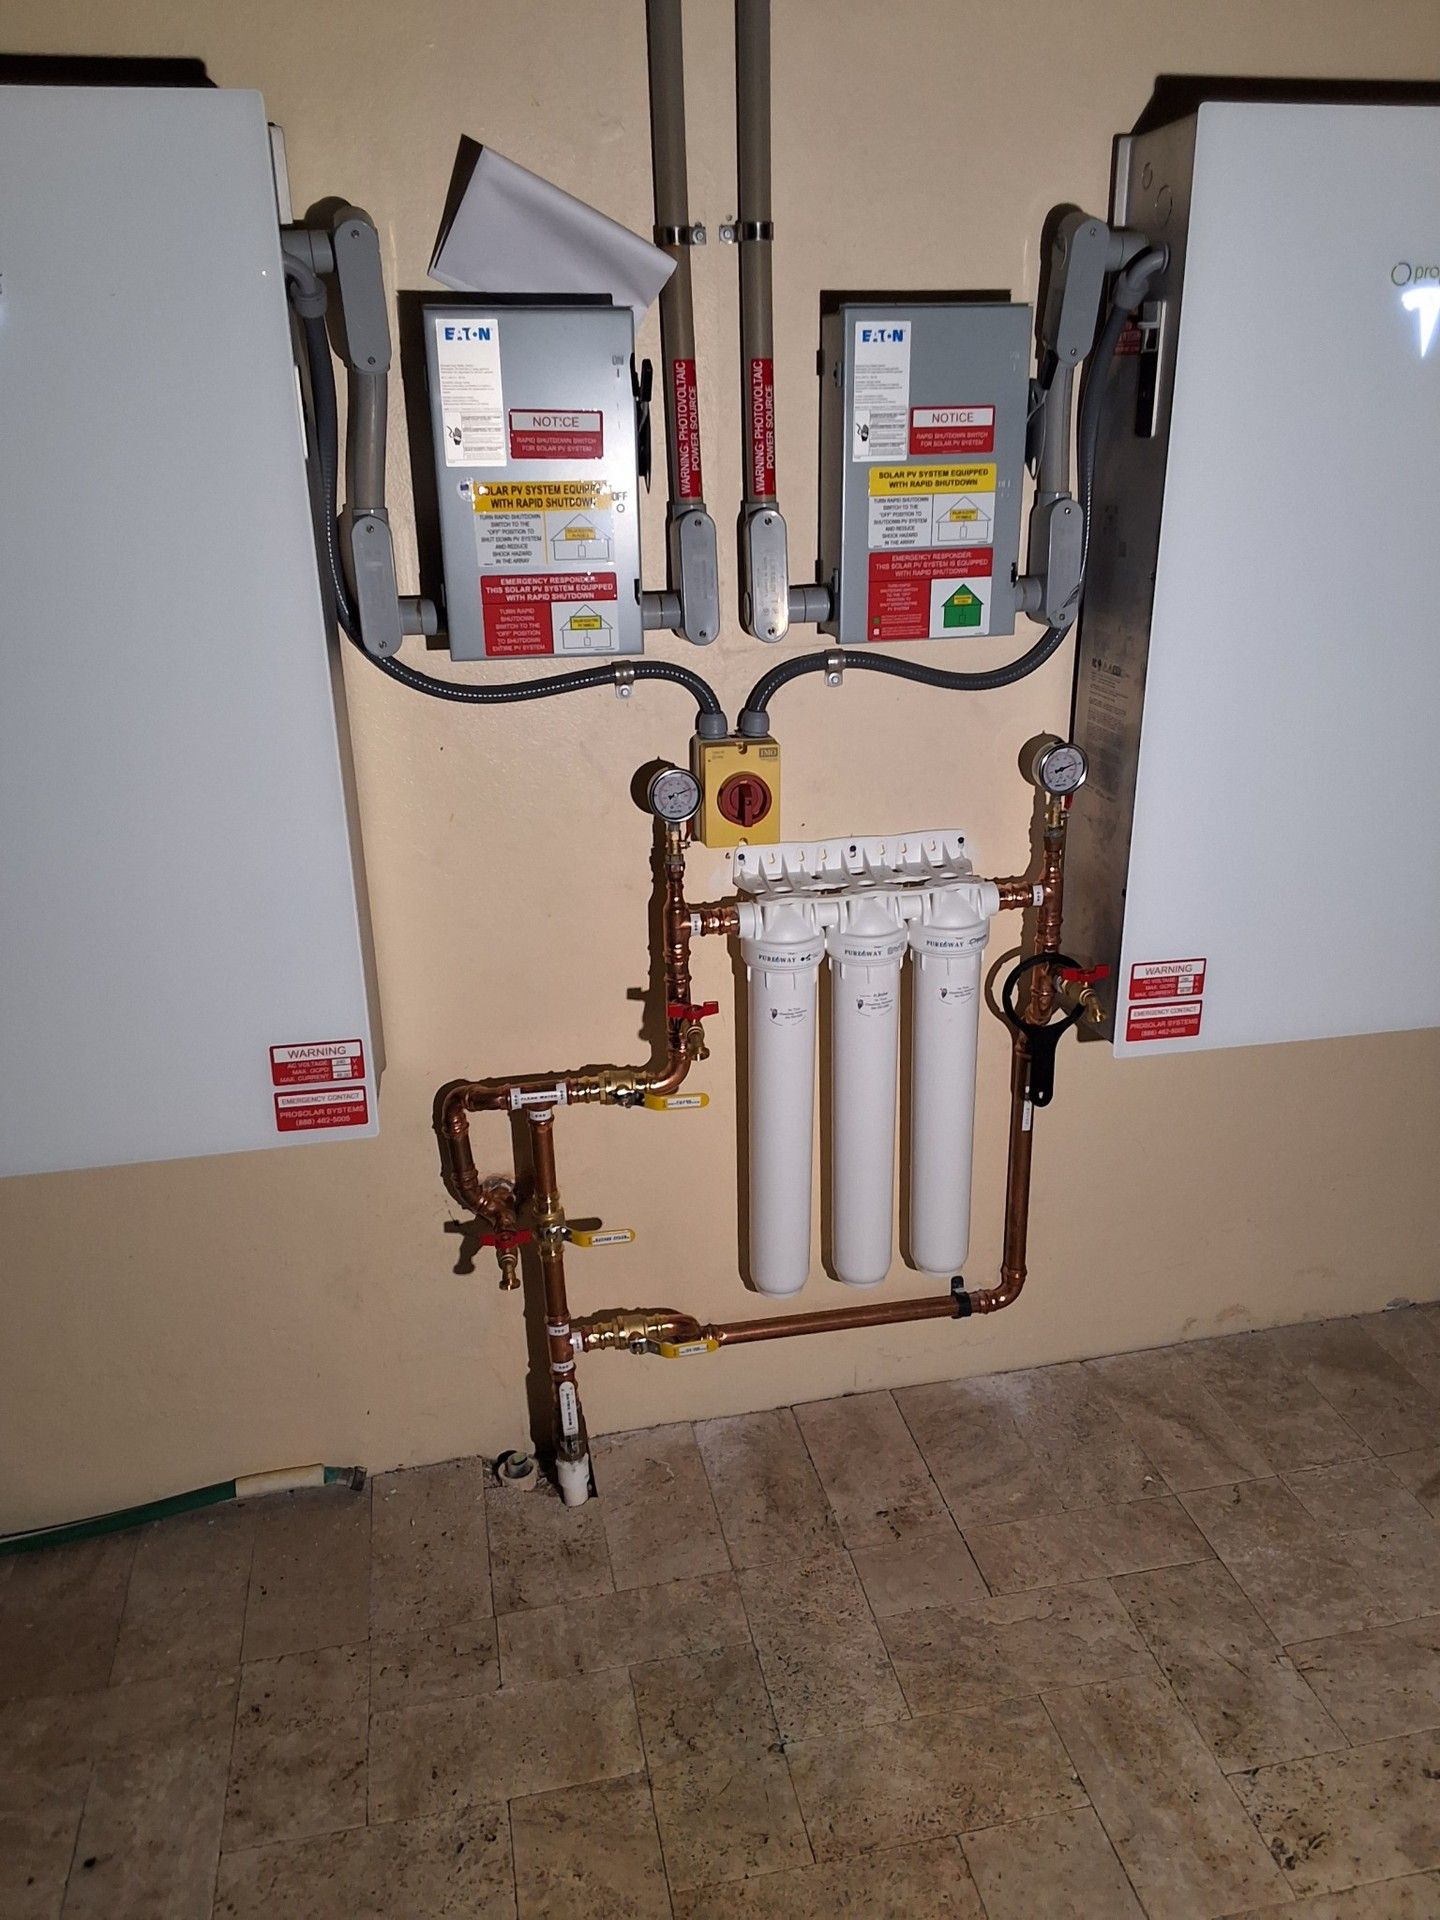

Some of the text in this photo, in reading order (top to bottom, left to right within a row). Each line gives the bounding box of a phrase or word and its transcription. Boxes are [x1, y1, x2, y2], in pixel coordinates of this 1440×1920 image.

[675, 361, 688, 441] PHOTOVOLTAIC
[753, 360, 764, 439] PHOTOVOLTAIC
[532, 416, 580, 428] NOTICE
[932, 412, 974, 423] NOTICE
[688, 385, 700, 472] POWER SOURCE
[765, 384, 774, 469] POWER SOURCE
[878, 472, 905, 480] SOLAR
[918, 470, 949, 478] SYSTEM
[950, 468, 988, 476] EQUIPPED
[935, 479, 978, 487] SHUTDOWN
[478, 484, 508, 496] OLAR
[511, 485, 522, 495] PV
[526, 484, 560, 495] SYSTEM
[490, 498, 514, 509] WITH
[516, 498, 544, 508] RAPID
[1145, 964, 1193, 975] WARNING
[1134, 1006, 1197, 1017] EMERGENCY CONTACT
[288, 1046, 347, 1059] WARNING
[282, 1092, 360, 1105] EMERGENCY CONTACT
[280, 1106, 365, 1118] PROSOLAR SYSTEMS
